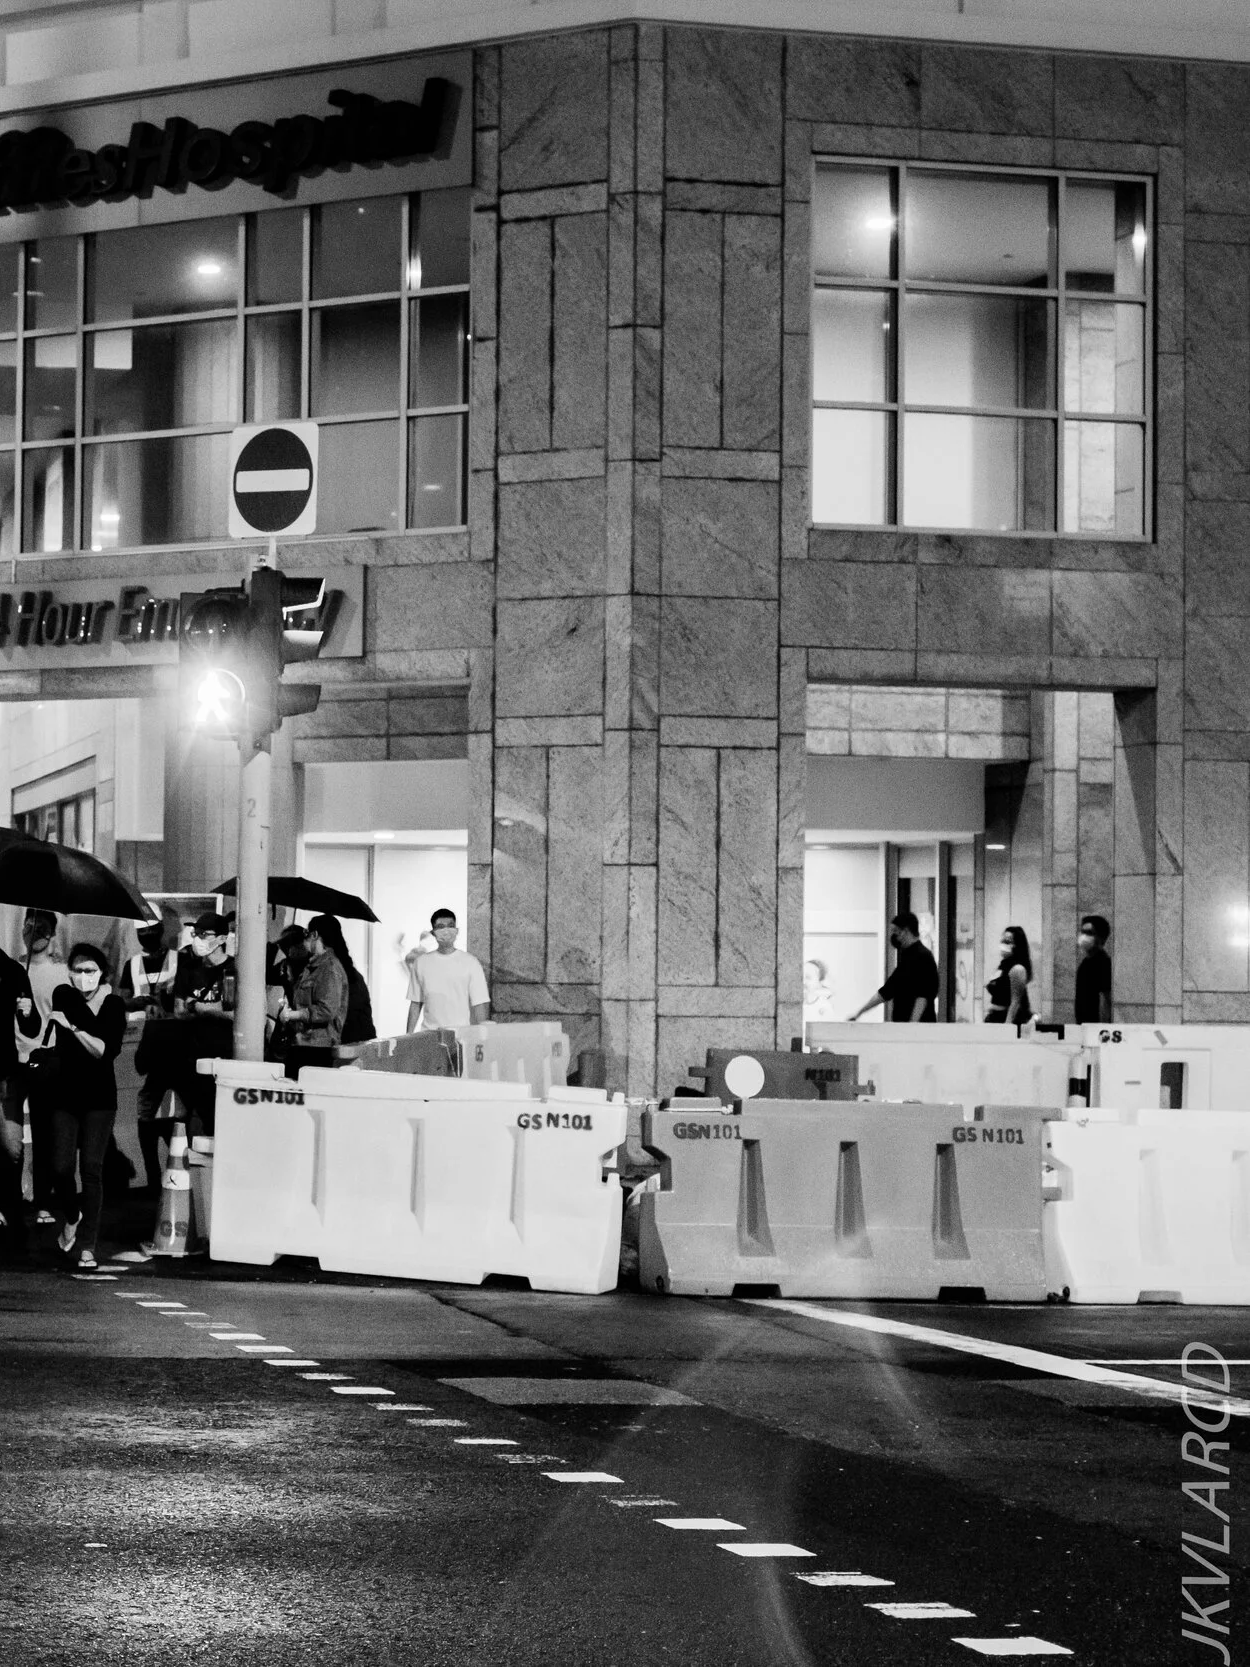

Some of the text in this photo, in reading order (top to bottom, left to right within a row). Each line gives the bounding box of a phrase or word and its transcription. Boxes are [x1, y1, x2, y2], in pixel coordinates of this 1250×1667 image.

[17, 590, 115, 647] Hour
[1099, 1029, 1123, 1044] GS
[159, 1219, 189, 1239] GS
